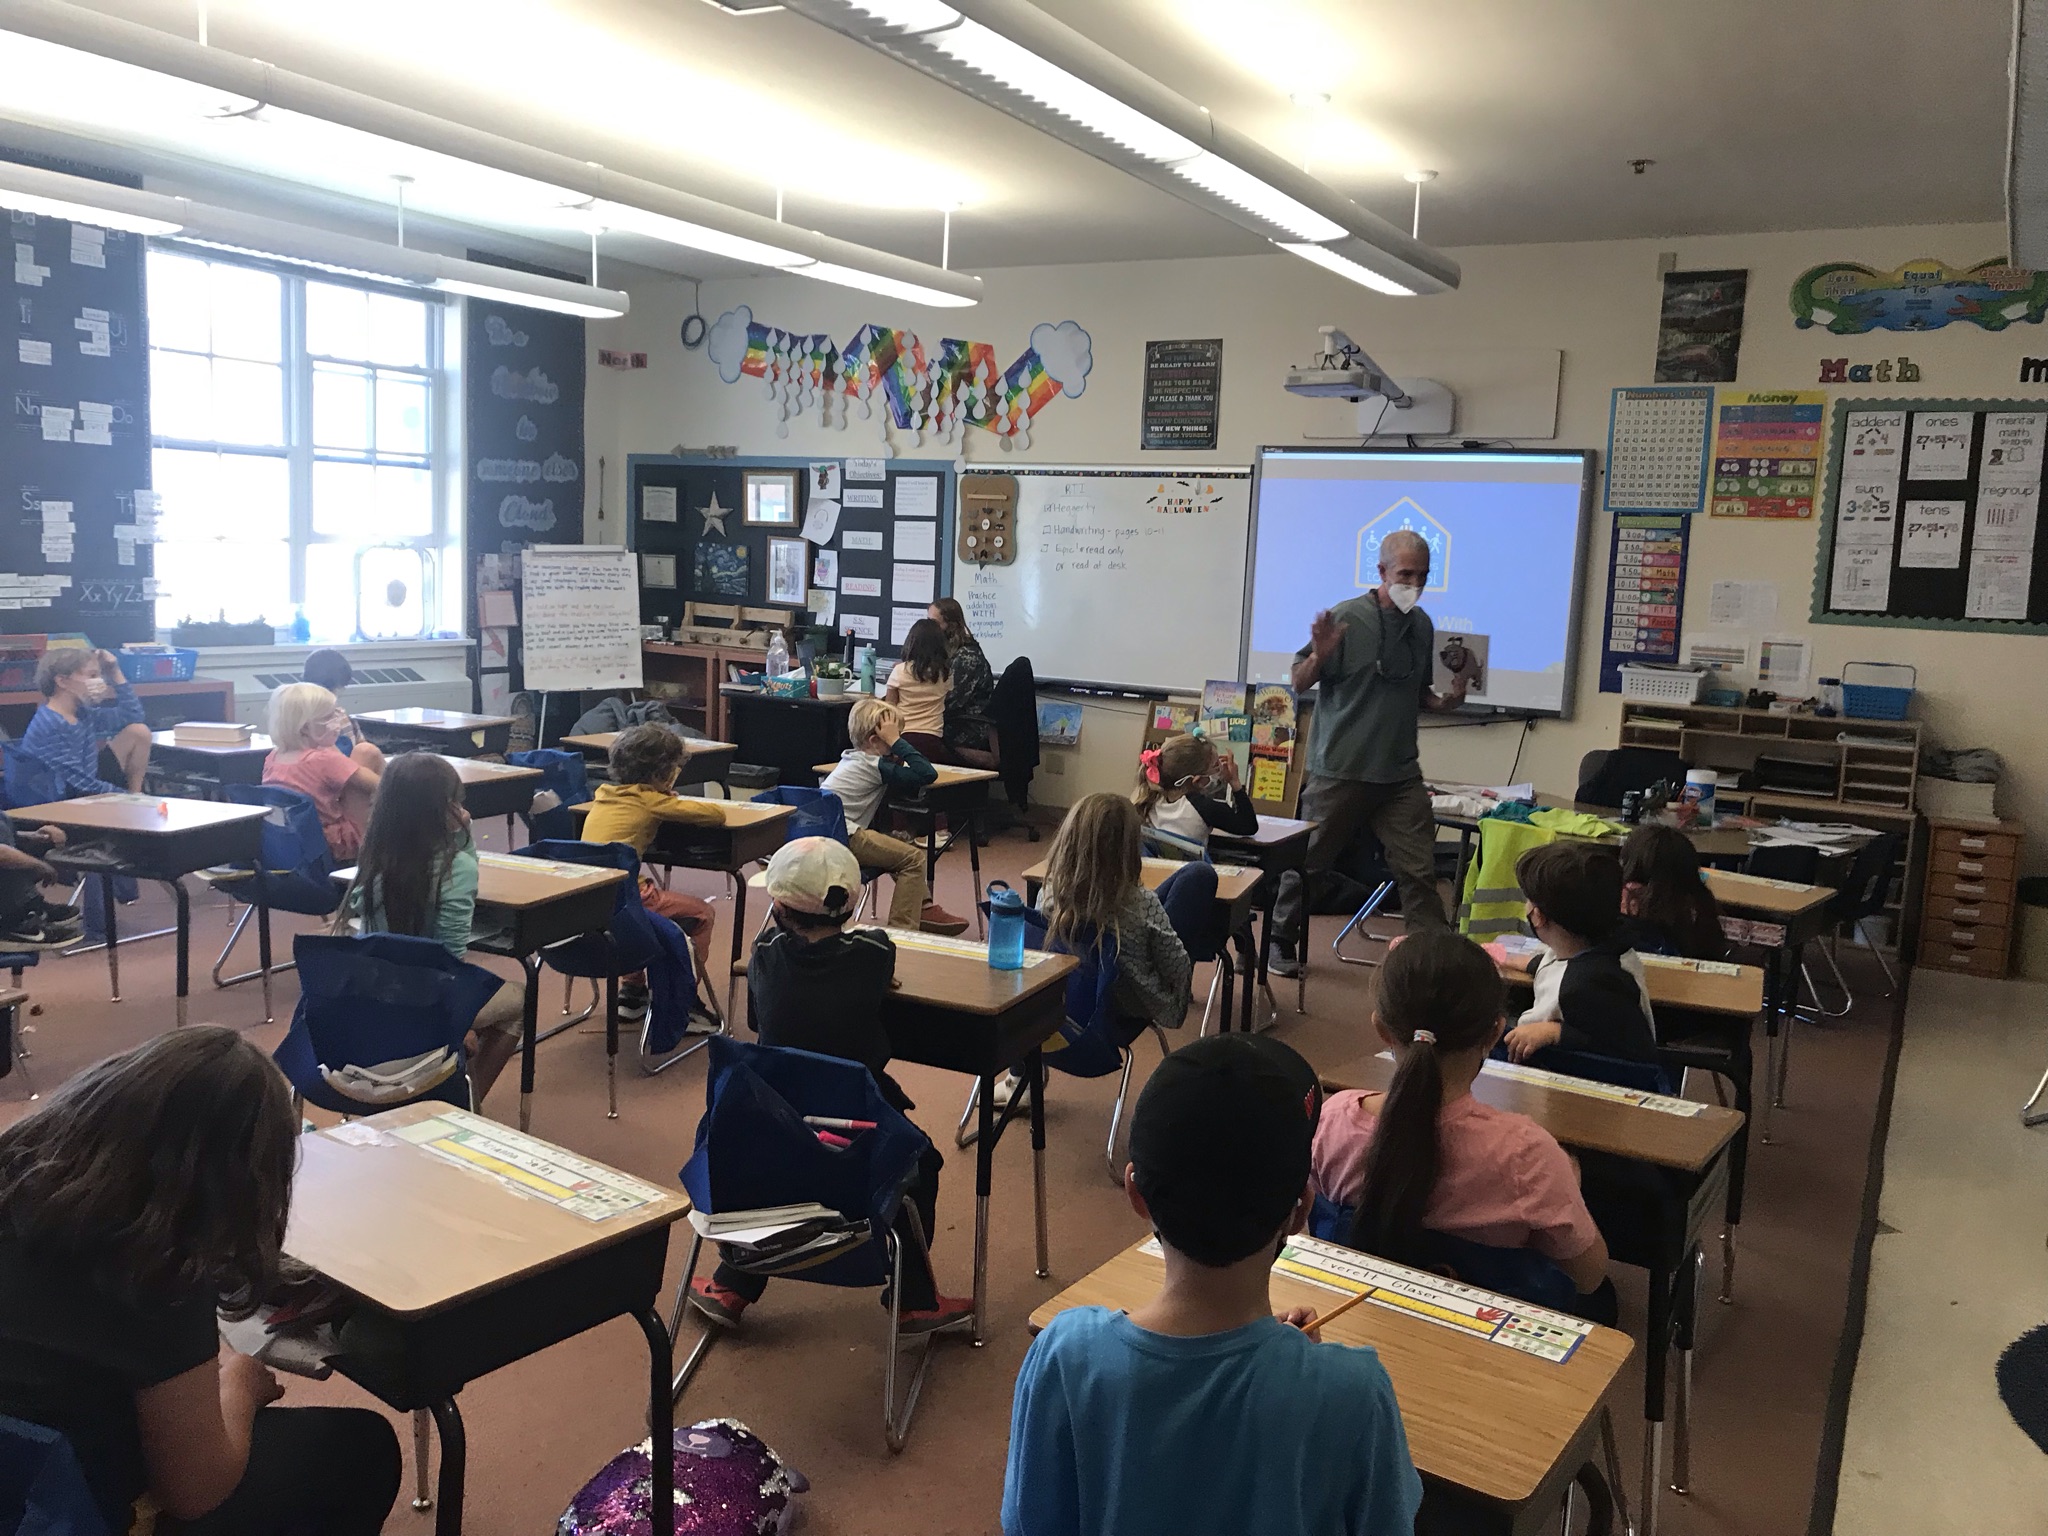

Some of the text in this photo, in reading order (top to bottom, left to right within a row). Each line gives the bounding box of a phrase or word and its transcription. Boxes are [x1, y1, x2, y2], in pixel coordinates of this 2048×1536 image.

[1904, 271, 1942, 282] Equal
[1913, 285, 1928, 294] To
[1819, 357, 1920, 382] Math
[1747, 394, 1798, 404] Money
[16, 396, 40, 415] Nn
[1852, 417, 1900, 428] addend
[1926, 418, 1959, 427] ones
[1996, 416, 2035, 425] mental
[1999, 429, 2029, 438] math
[1856, 434, 1864, 445] 2
[1065, 483, 1085, 494] RTI
[1855, 485, 1884, 494] sum
[1983, 487, 2034, 498] regroup
[22, 492, 40, 511] Ss
[847, 495, 879, 503] WRITING:
[1157, 505, 1210, 514] HALLOWEEN
[1920, 505, 1950, 515] tens
[1054, 524, 1105, 540] Handwriting
[1115, 528, 1139, 539] pages
[1108, 546, 1124, 556] only
[1072, 560, 1090, 569] read
[1108, 561, 1127, 570] desk
[974, 572, 998, 584] Math
[845, 583, 877, 592] READING:
[968, 590, 997, 600] Practice
[972, 609, 995, 618] WITH
[968, 620, 1004, 631] regrouping
[1438, 615, 1473, 631] With
[1320, 1258, 1443, 1301] Everett Glaser
